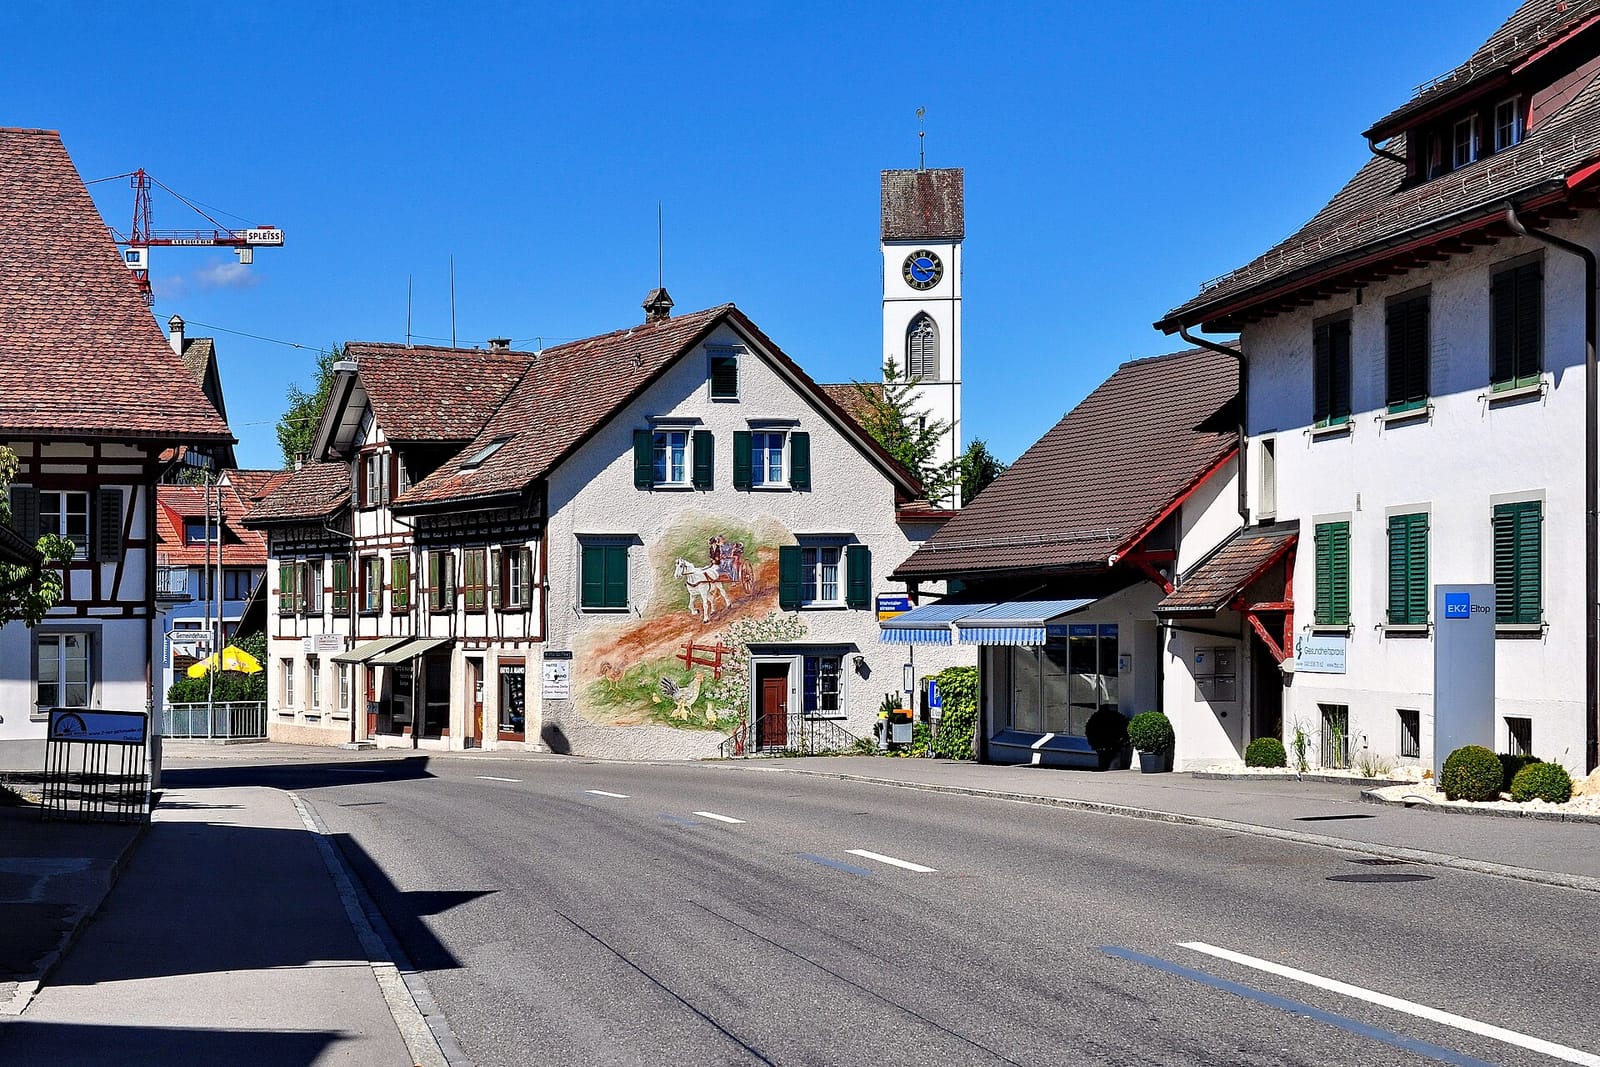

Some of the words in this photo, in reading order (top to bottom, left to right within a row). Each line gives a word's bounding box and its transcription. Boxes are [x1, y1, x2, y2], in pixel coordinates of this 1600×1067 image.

[248, 231, 280, 240] SPLEISS
[1447, 604, 1467, 613] EKZ
[1470, 604, 1491, 614] Eltop
